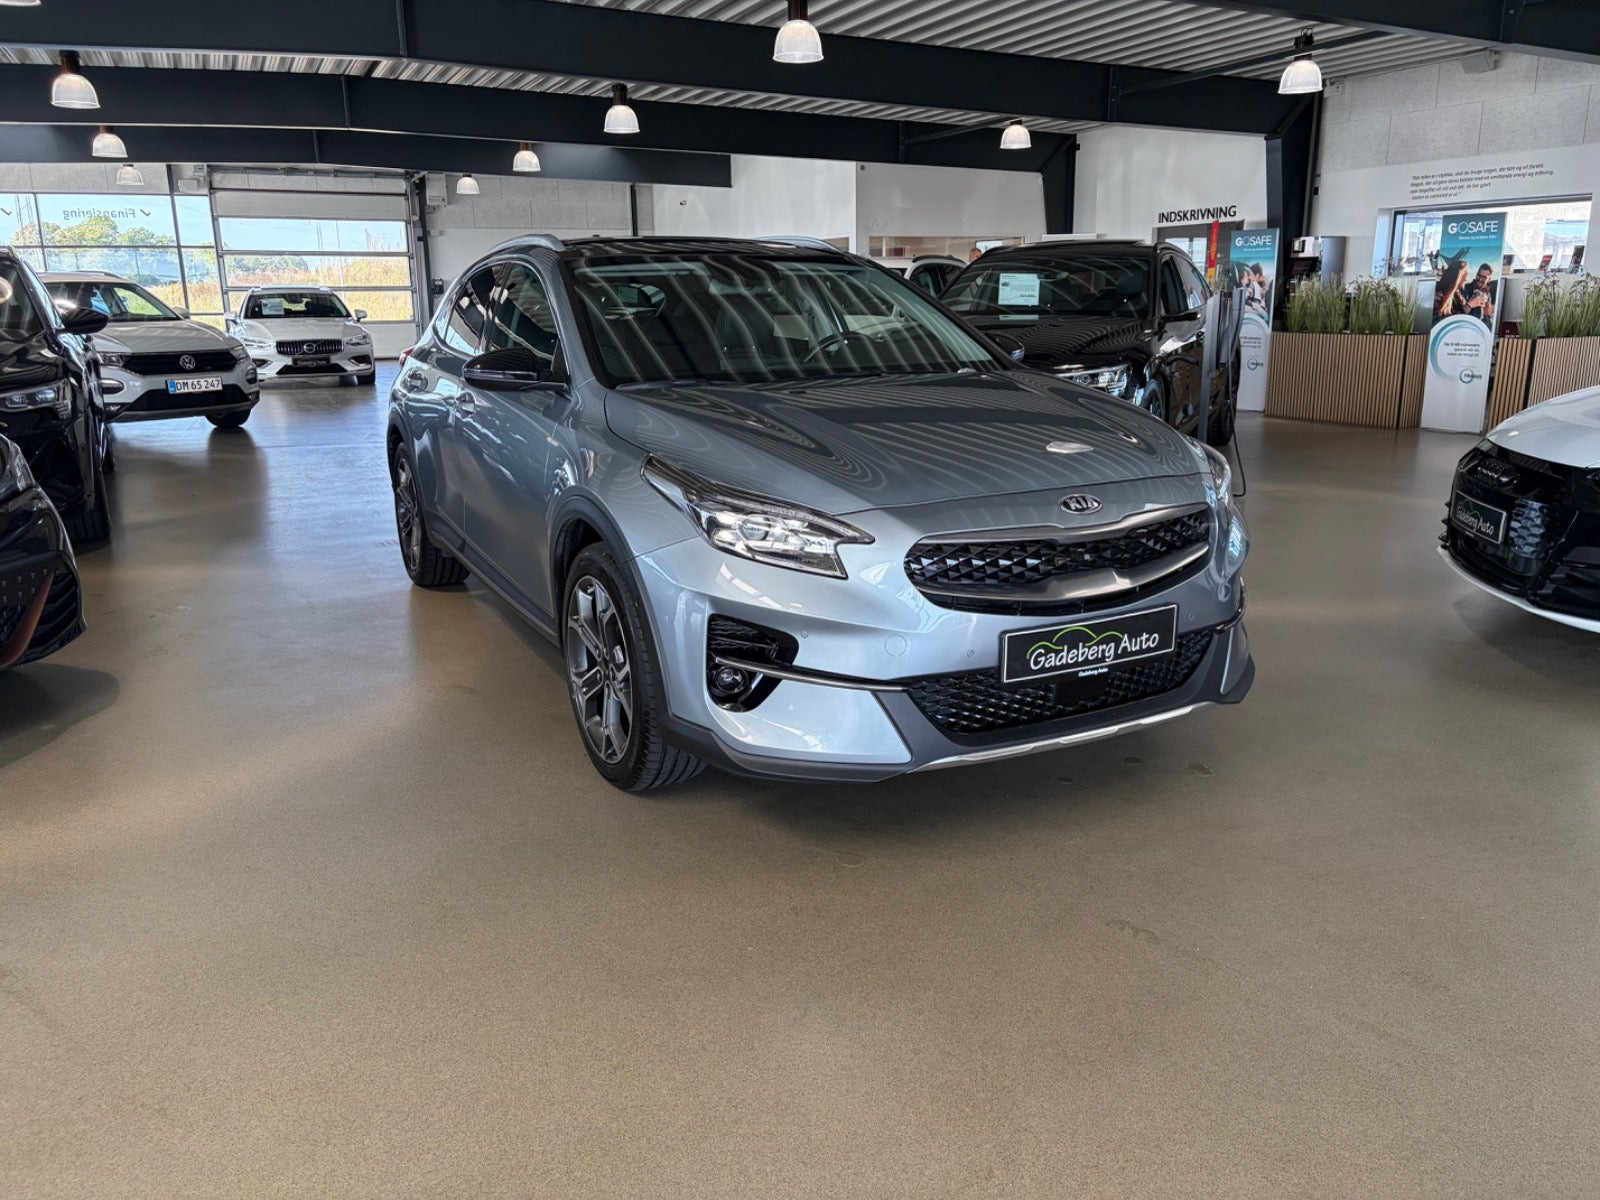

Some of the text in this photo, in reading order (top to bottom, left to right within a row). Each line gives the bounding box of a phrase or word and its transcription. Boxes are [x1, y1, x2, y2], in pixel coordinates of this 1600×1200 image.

[1158, 205, 1237, 224] INDSKRIVNING
[1448, 220, 1499, 234] GOSAFE
[1235, 235, 1272, 247] GOSAFE
[176, 379, 220, 392] DM 65 247
[1065, 495, 1099, 511] KIA
[1478, 516, 1494, 535] Auto
[1030, 632, 1159, 670] Gadeberg Auto
